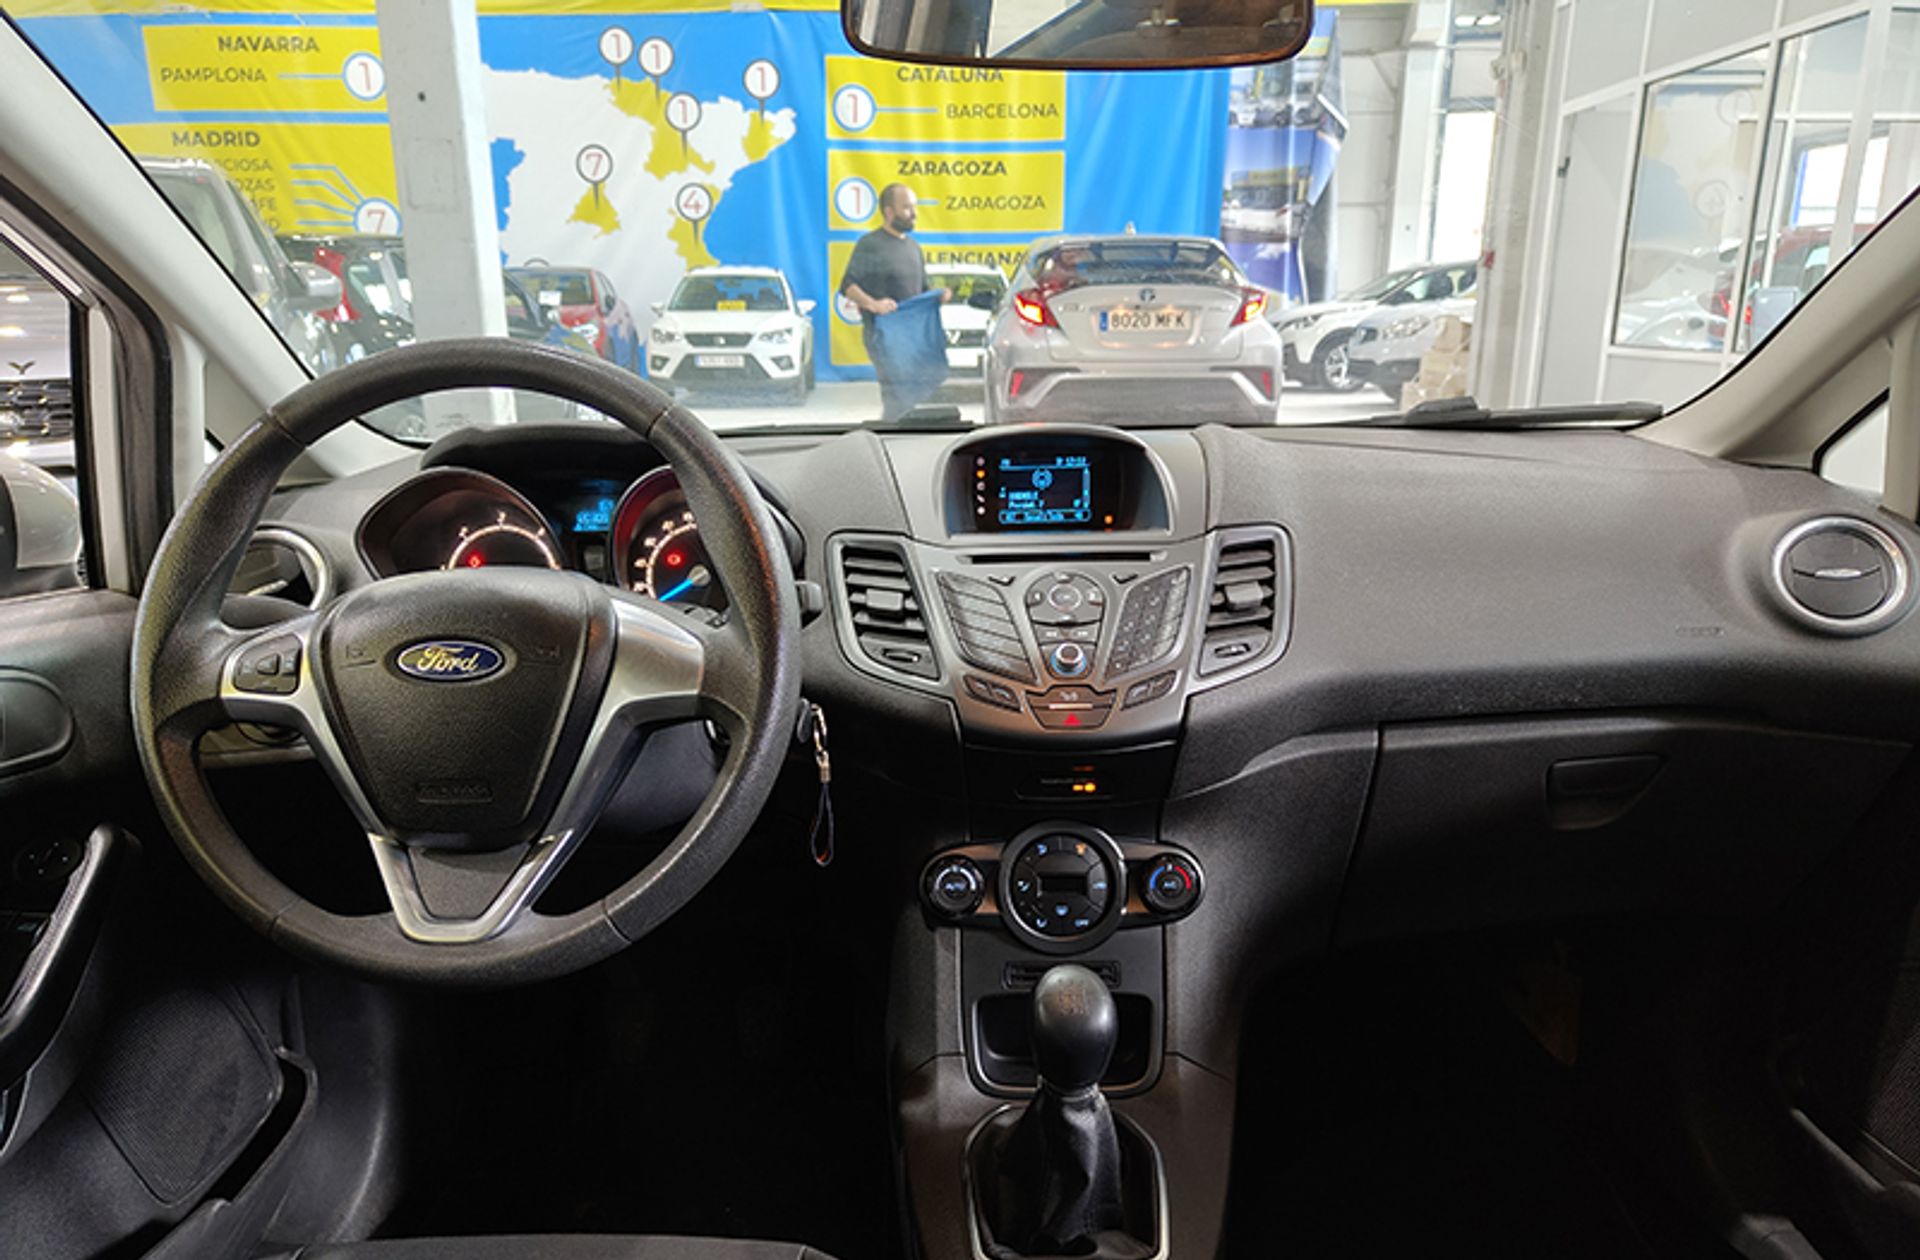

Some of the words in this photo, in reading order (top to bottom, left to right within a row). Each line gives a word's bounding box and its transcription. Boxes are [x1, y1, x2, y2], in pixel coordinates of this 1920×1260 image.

[217, 35, 320, 53] NAVARRA
[612, 34, 622, 57] 1
[651, 45, 661, 69] 1
[160, 67, 268, 83] PAMPLONA
[358, 61, 372, 92] 1
[757, 67, 767, 92] 1
[678, 99, 688, 123] 1
[847, 93, 859, 124] 1
[946, 103, 1059, 119] BARCELONA
[172, 130, 261, 148] MADRID
[586, 154, 603, 176] 7
[898, 160, 1007, 176] ZARAGOZA
[683, 190, 703, 213] 4
[851, 186, 862, 215] 1
[946, 195, 1046, 211] ZARAGOZA
[927, 251, 1027, 266] LENCIANA
[1111, 312, 1151, 329] 8020
[416, 645, 480, 672] Ford
